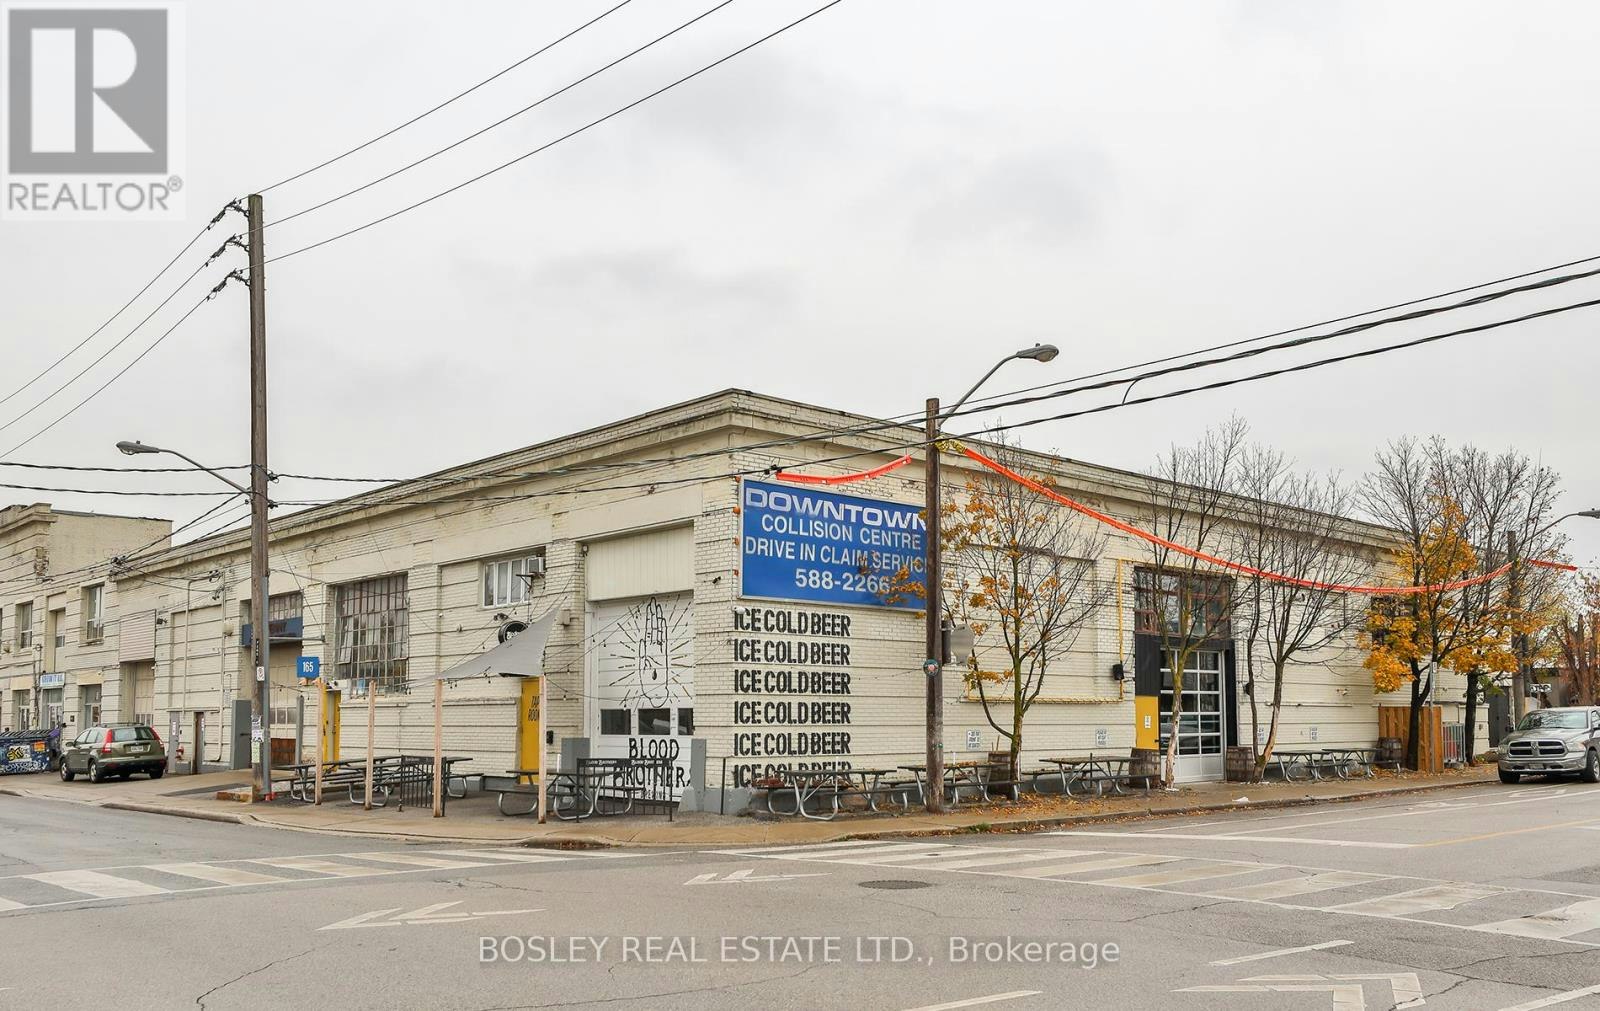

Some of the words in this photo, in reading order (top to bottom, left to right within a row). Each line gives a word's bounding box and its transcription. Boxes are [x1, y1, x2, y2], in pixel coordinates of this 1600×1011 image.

[761, 514, 853, 543] COLLISION
[859, 528, 921, 550] CENTRE
[745, 536, 795, 560] DRIVE
[799, 544, 816, 562] IN
[820, 546, 868, 568] CLAIM
[872, 552, 926, 573] SERVIC
[795, 568, 890, 593] 588-2266
[734, 608, 761, 632] ICE
[764, 609, 808, 634] COLD
[811, 612, 851, 637] BEER
[734, 639, 761, 662] ICE
[764, 640, 808, 664] COLD
[811, 642, 851, 665] BEER
[302, 661, 314, 673] 165
[734, 669, 761, 693] ICE
[764, 671, 808, 694] COLD
[811, 672, 851, 694] BEER
[734, 701, 761, 724] ICE
[764, 701, 808, 724] COLD
[811, 702, 851, 724] BEER
[629, 738, 680, 760] BLOOD
[734, 733, 761, 756] ICE
[764, 733, 808, 755] COLD
[811, 732, 851, 754] BEER
[613, 766, 690, 788] BROTHER
[734, 764, 762, 788] ICE
